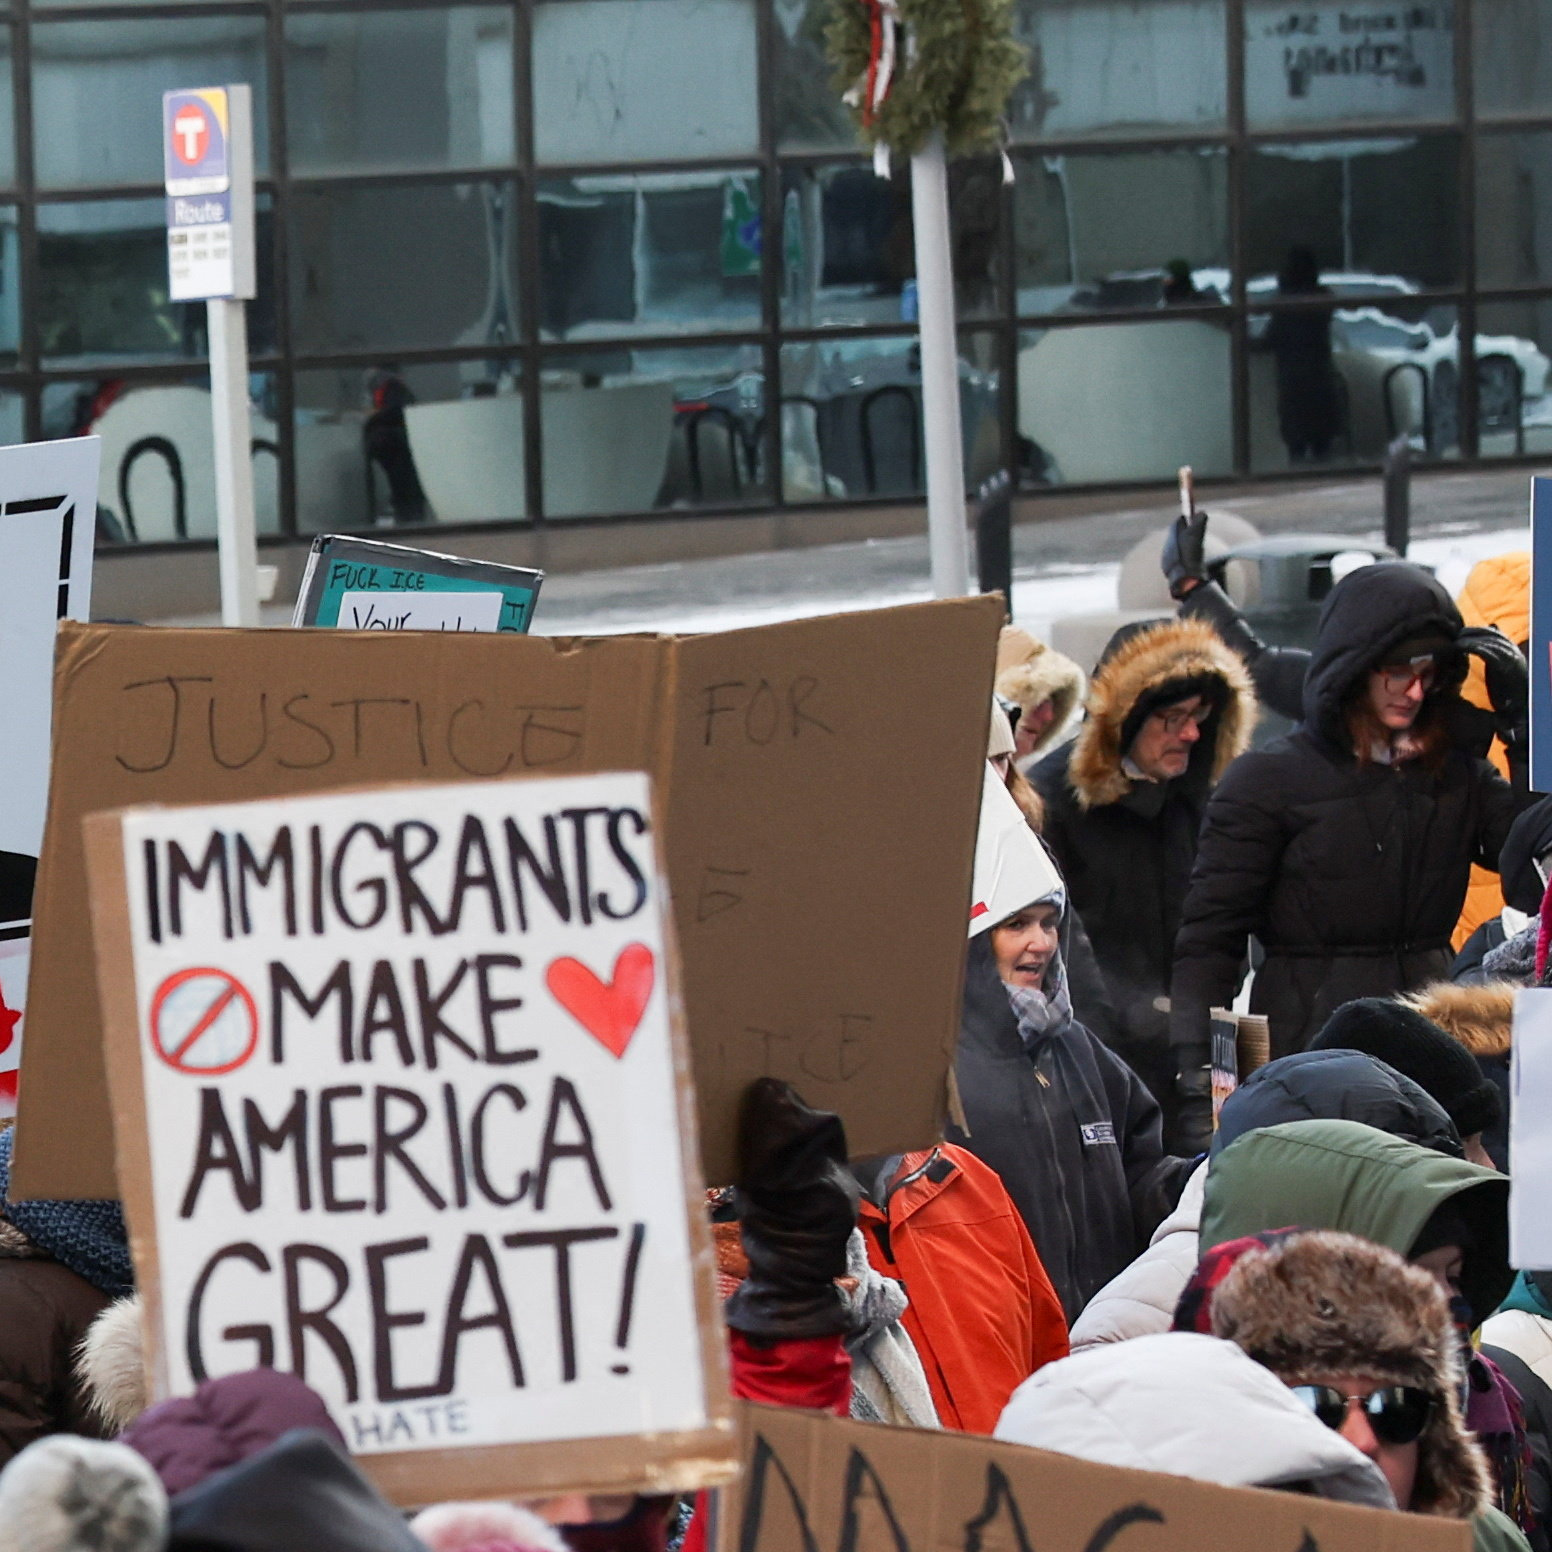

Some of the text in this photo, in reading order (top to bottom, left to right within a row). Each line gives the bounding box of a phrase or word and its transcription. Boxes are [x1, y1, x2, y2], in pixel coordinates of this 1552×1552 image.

[174, 199, 225, 224] Route
[330, 563, 380, 590] FUCK
[115, 673, 834, 776] JUSTICE FOR
[141, 806, 649, 944] IMMIGRANTS
[269, 952, 539, 1070] MAKE
[179, 1076, 613, 1220] AMERICA
[186, 1222, 647, 1403] GREAT!
[351, 1401, 470, 1447] HATE
